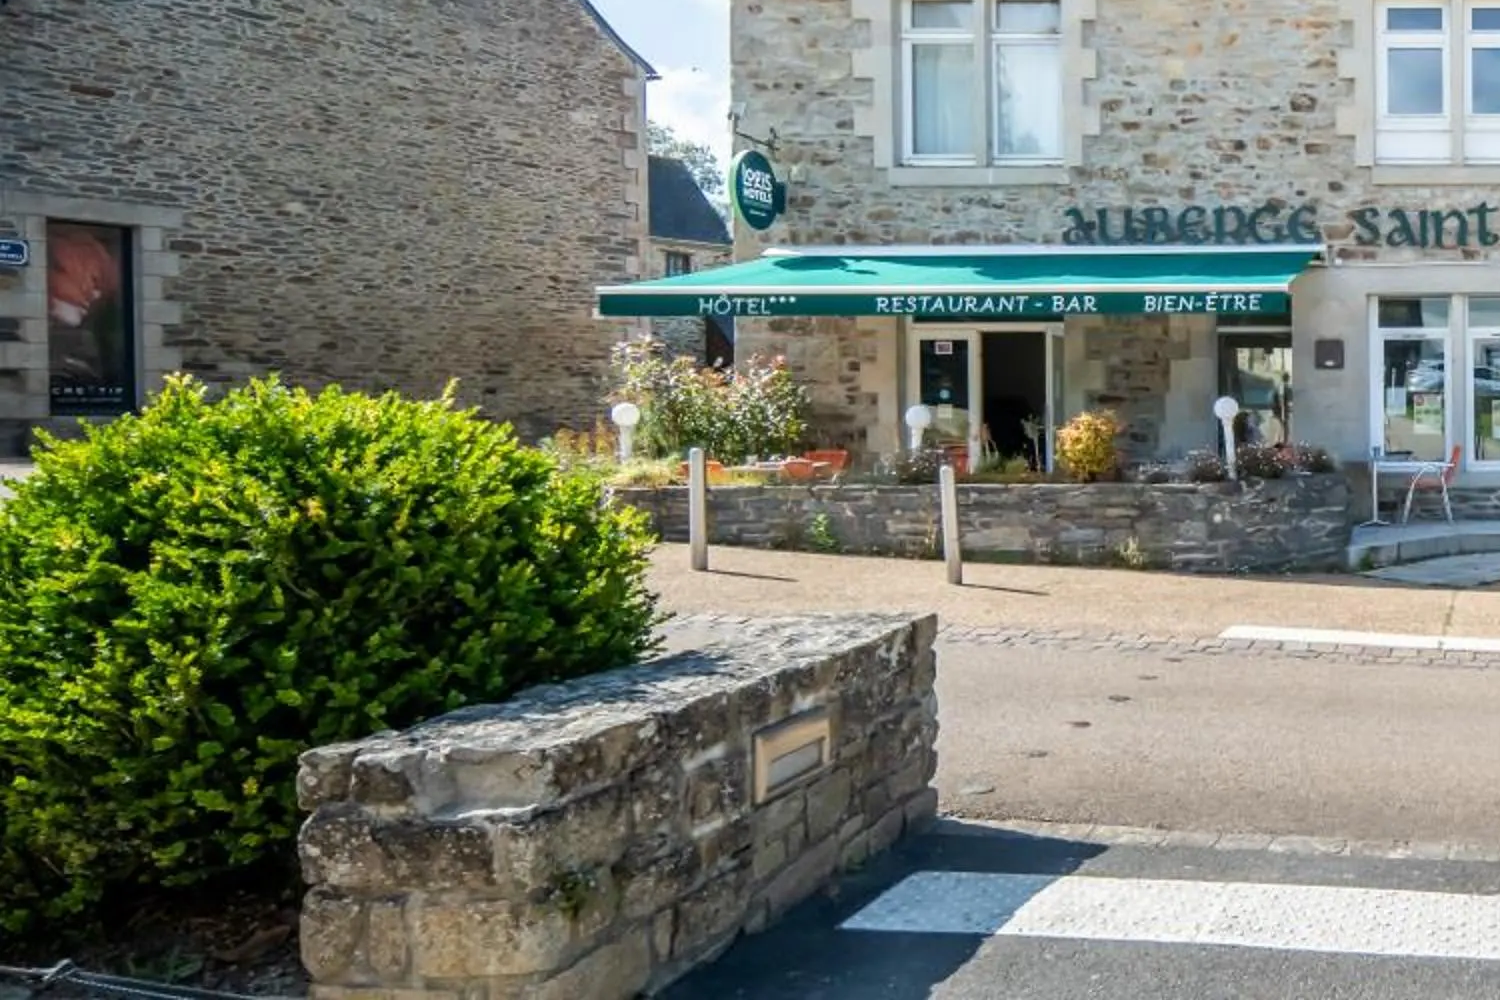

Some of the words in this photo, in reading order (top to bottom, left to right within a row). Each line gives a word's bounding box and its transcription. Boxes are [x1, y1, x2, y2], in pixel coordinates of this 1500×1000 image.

[876, 295, 1029, 314] RESTAURANT
[1051, 295, 1098, 313] BAR
[1144, 292, 1263, 312] BIEN-ÊTRE
